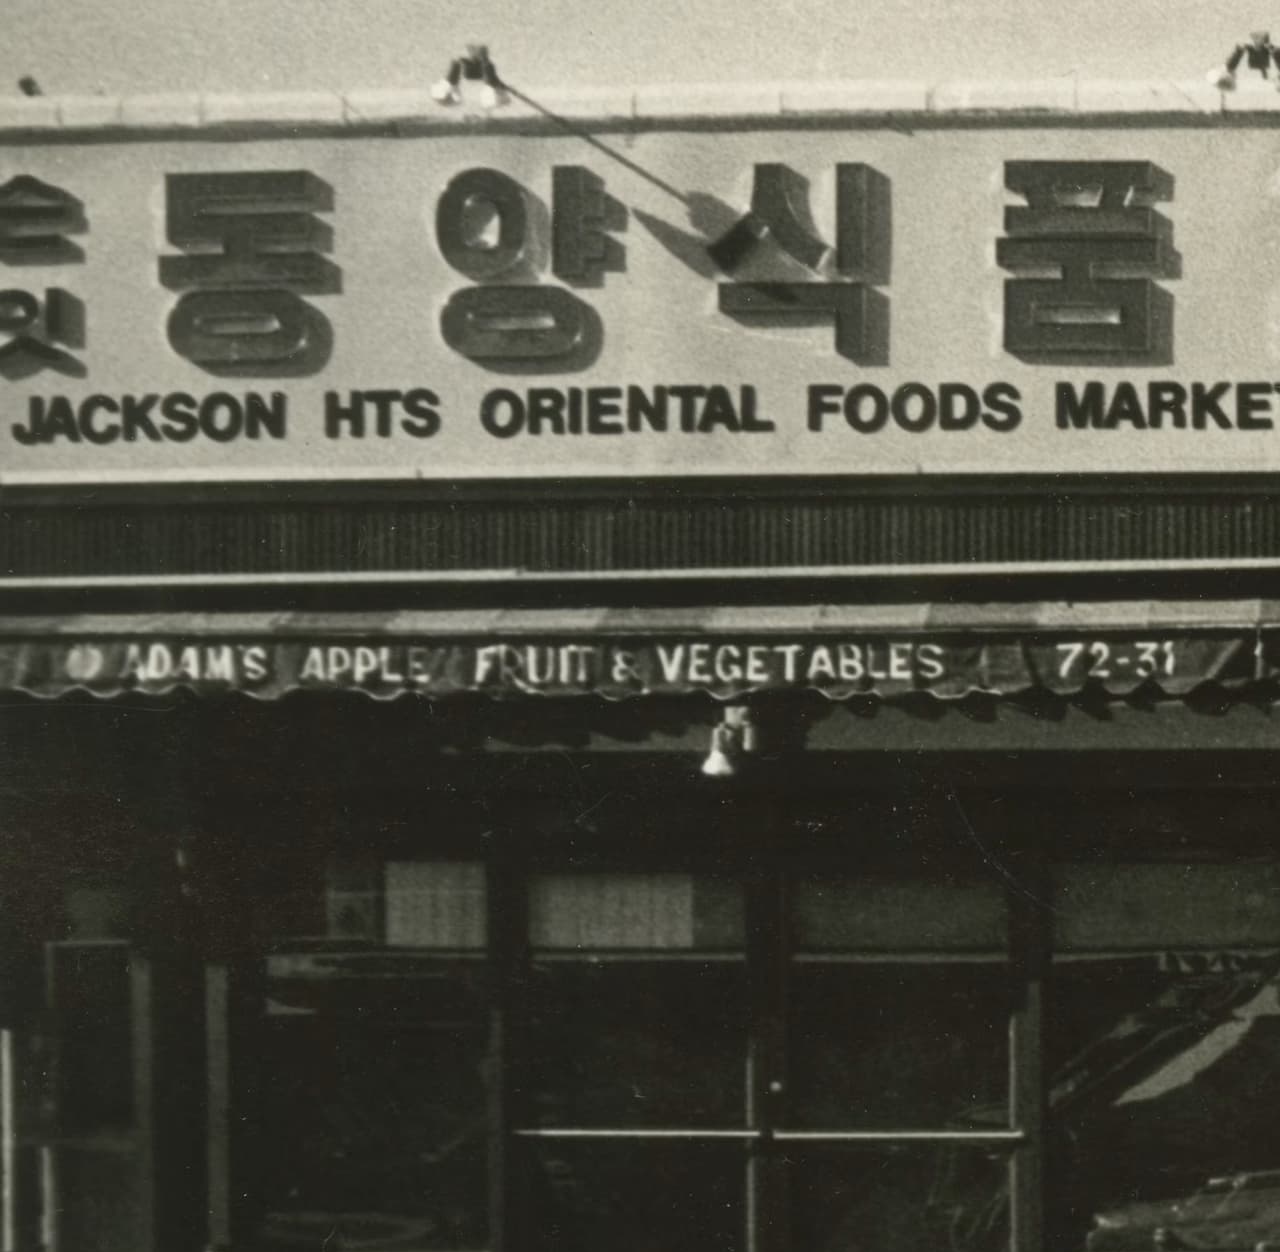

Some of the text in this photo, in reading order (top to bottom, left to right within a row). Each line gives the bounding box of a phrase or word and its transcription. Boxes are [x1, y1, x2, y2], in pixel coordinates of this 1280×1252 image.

[11, 391, 287, 445] JACKSON
[324, 388, 441, 439] HTS
[479, 385, 776, 438] ORIENTAL
[806, 382, 1022, 433] FOODS
[301, 645, 431, 683] APPLE
[474, 644, 596, 684] FRUIT
[611, 649, 643, 684] &
[656, 643, 945, 683] VEGETABLES
[1056, 641, 1176, 677] 72-31
